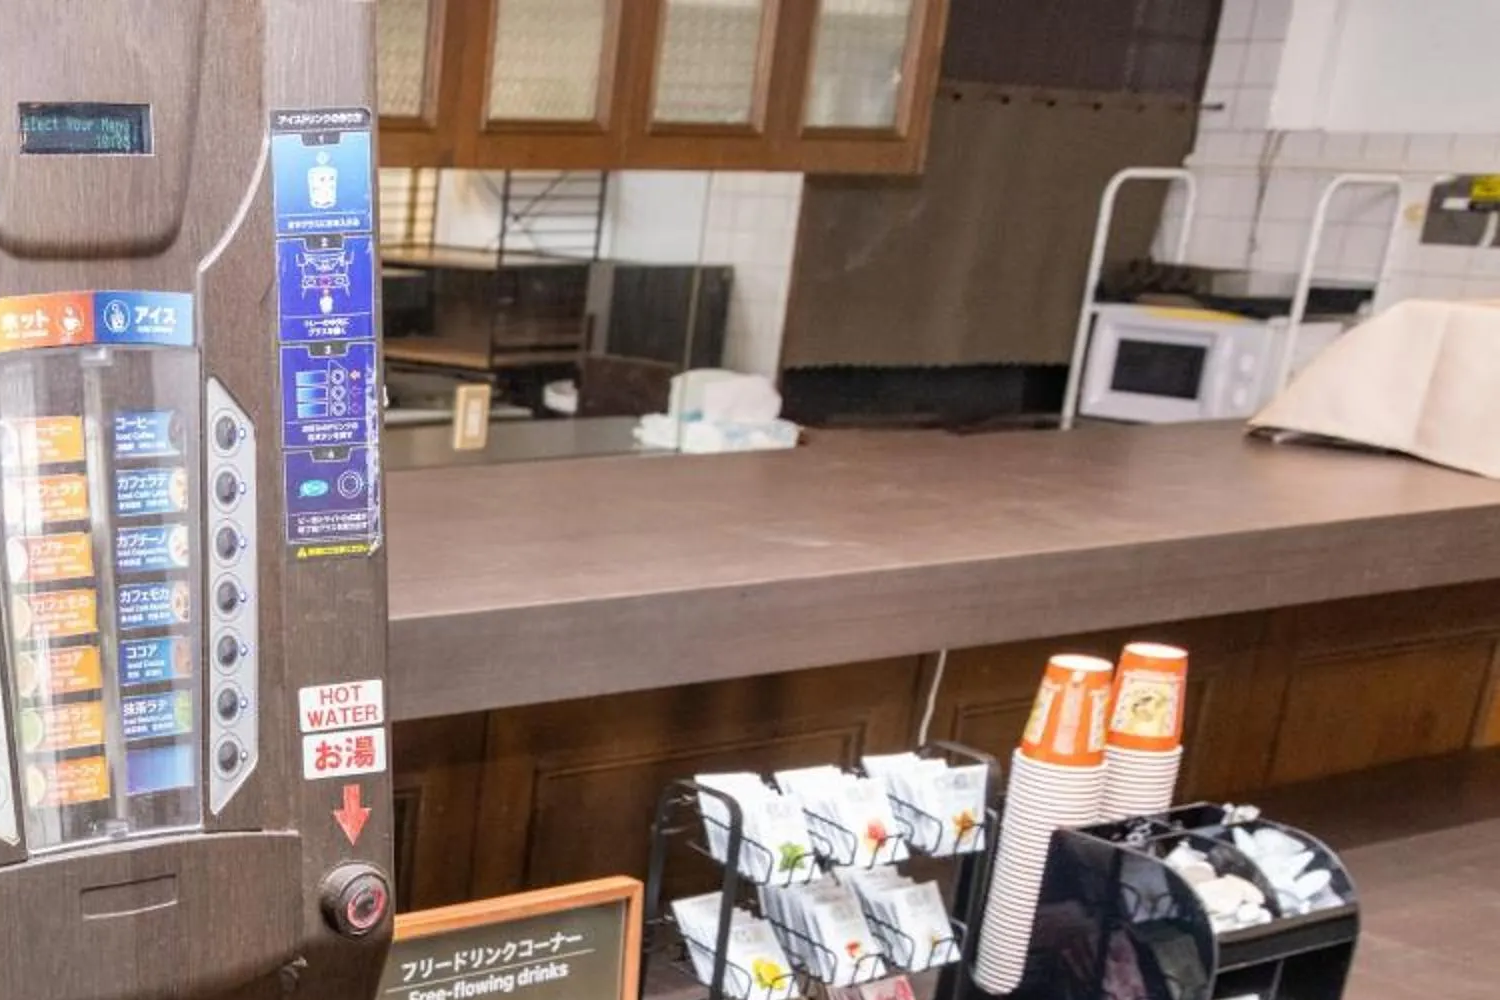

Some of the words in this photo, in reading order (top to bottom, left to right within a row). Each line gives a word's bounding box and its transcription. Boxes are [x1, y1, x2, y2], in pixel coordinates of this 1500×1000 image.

[133, 305, 177, 325] アイス
[115, 416, 158, 431] コーヒー
[126, 644, 159, 660] ココア
[319, 684, 363, 705] HOT
[307, 704, 379, 728] WATER
[314, 735, 375, 771] お湯
[401, 931, 583, 982] フリードリンクコーナー
[517, 961, 570, 986] drinks
